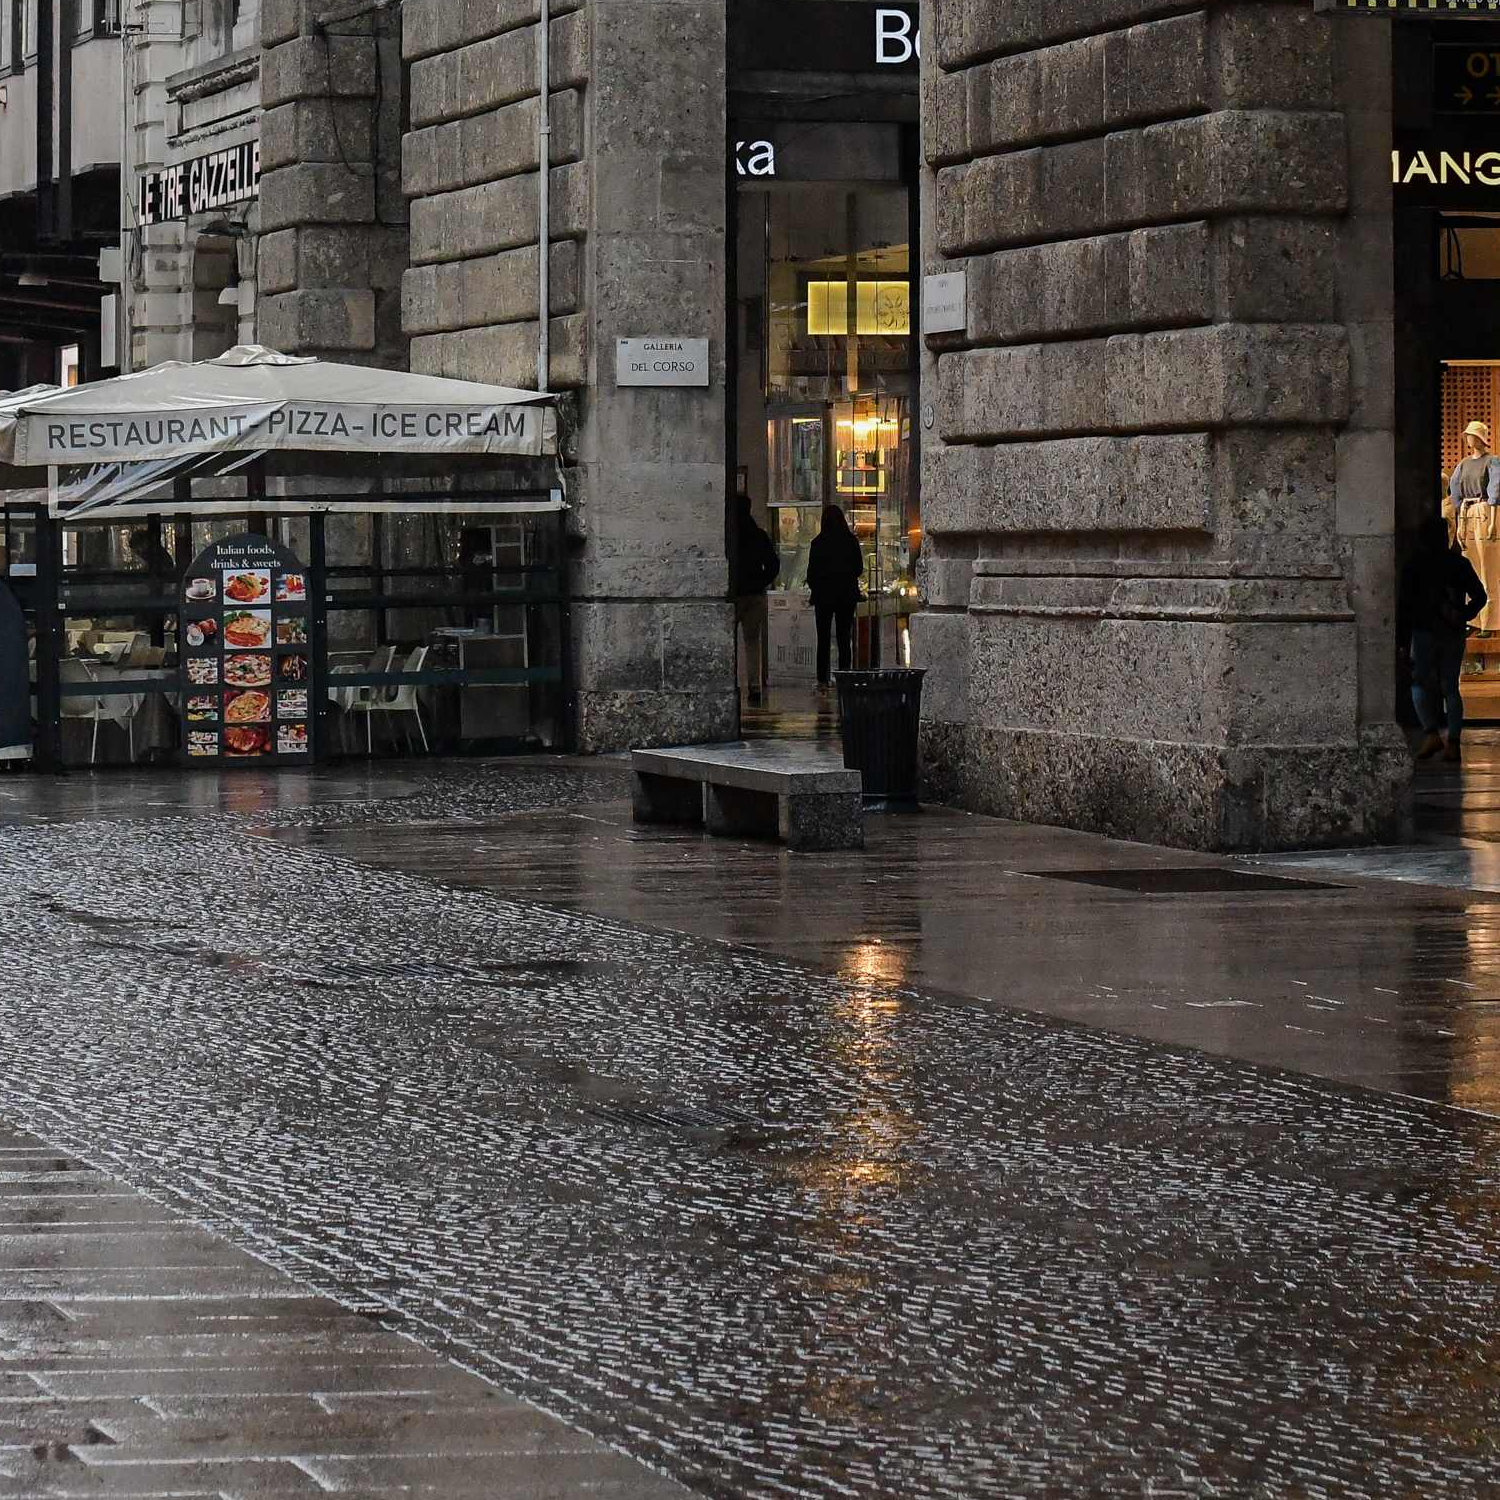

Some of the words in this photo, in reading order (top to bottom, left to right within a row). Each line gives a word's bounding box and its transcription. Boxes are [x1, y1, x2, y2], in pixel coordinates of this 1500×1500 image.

[875, 8, 920, 63] B
[139, 174, 154, 226] LE
[160, 164, 184, 221] TRE
[189, 141, 261, 214] GAZZELLE
[643, 343, 683, 351] GALLERIA
[631, 362, 650, 372] DEL
[653, 361, 695, 372] CORSO
[372, 412, 417, 438] ICE
[426, 411, 525, 438] CREAM
[216, 544, 245, 555] Italian
[247, 544, 275, 556] foods,
[211, 558, 240, 569] drinks
[241, 558, 250, 568] &
[252, 559, 281, 568] sweets
